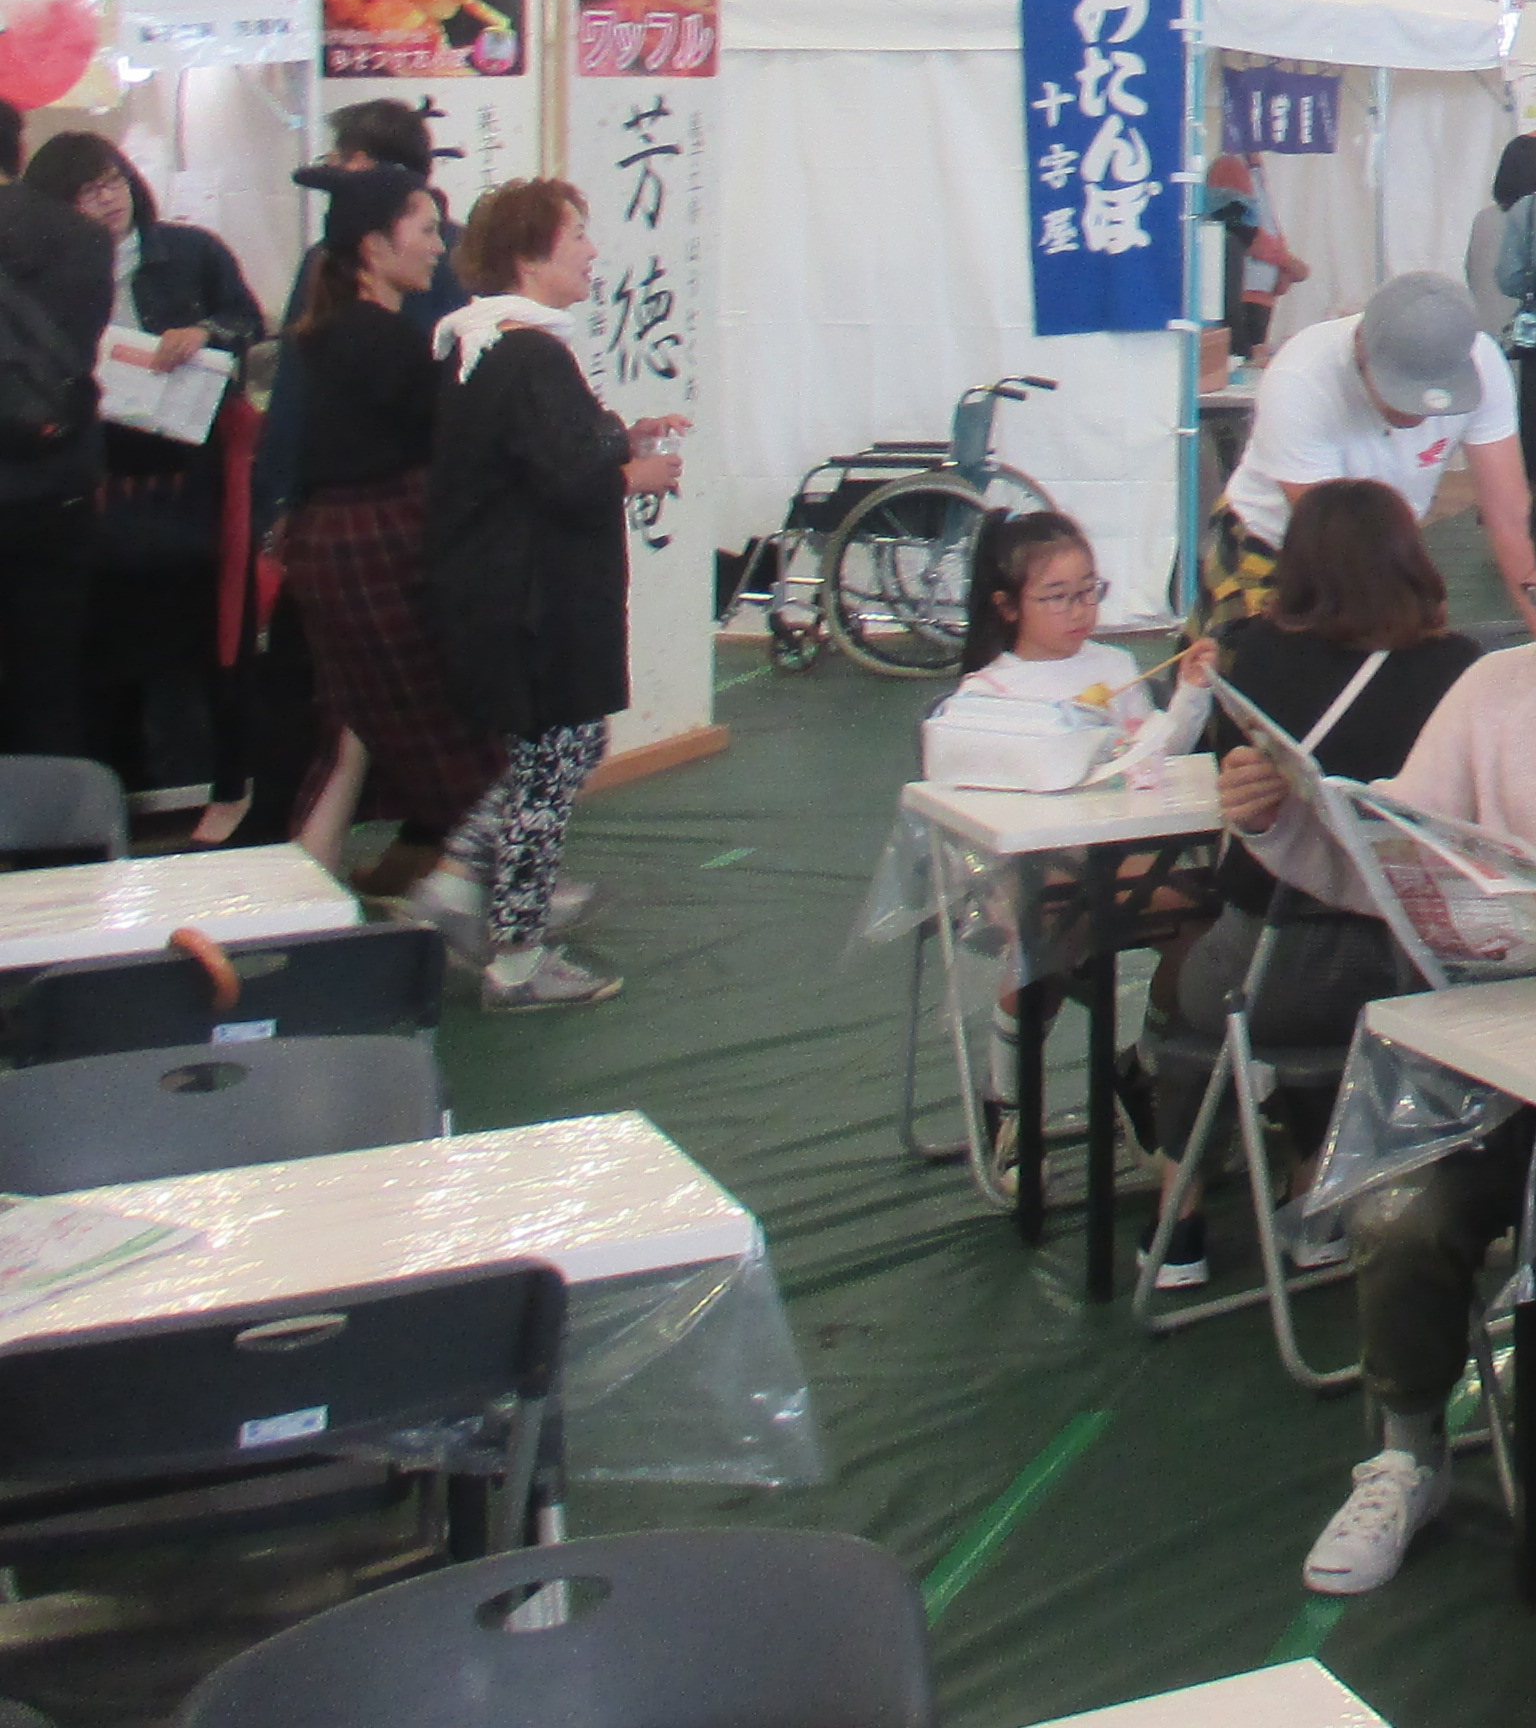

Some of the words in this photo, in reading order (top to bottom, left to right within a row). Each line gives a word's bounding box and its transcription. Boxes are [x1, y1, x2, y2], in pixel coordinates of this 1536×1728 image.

[580, 8, 716, 71] ワッフル
[1031, 81, 1079, 255] 十字屋
